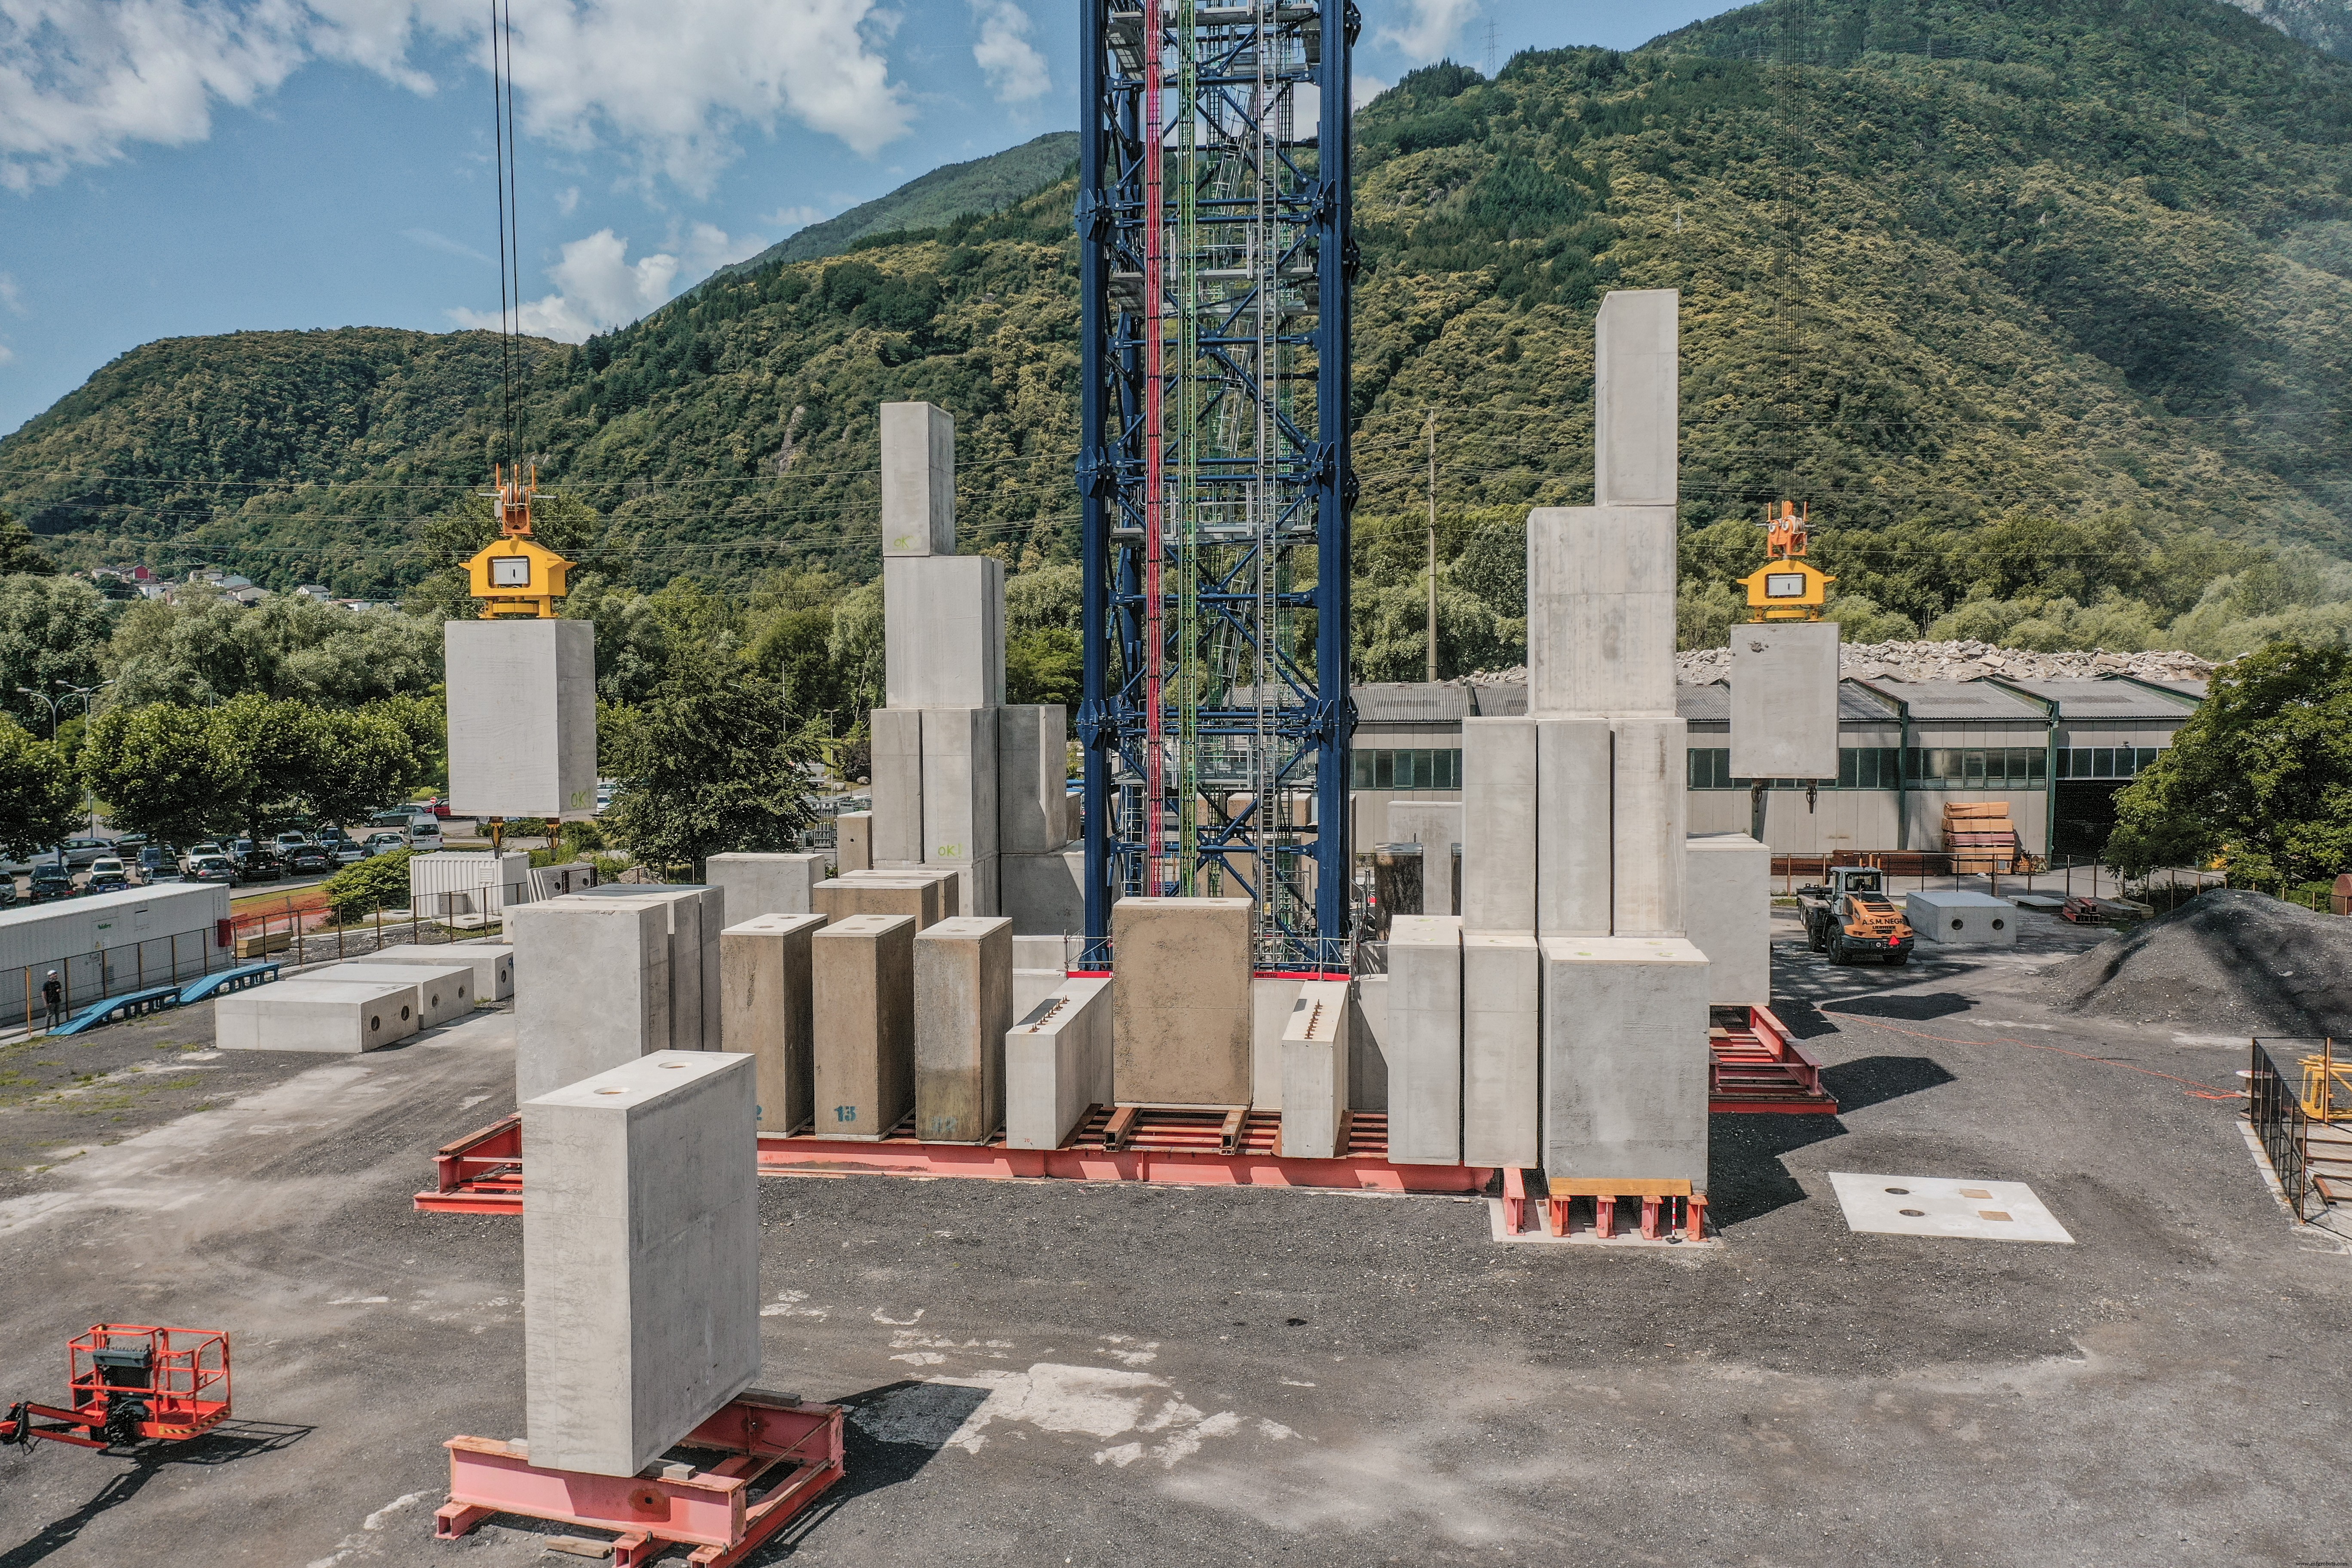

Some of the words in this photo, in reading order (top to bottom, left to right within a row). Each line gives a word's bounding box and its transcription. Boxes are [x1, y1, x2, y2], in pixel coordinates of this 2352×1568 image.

[571, 788, 591, 808] OK!
[938, 843, 962, 859] OK!
[834, 1105, 856, 1122] 13
